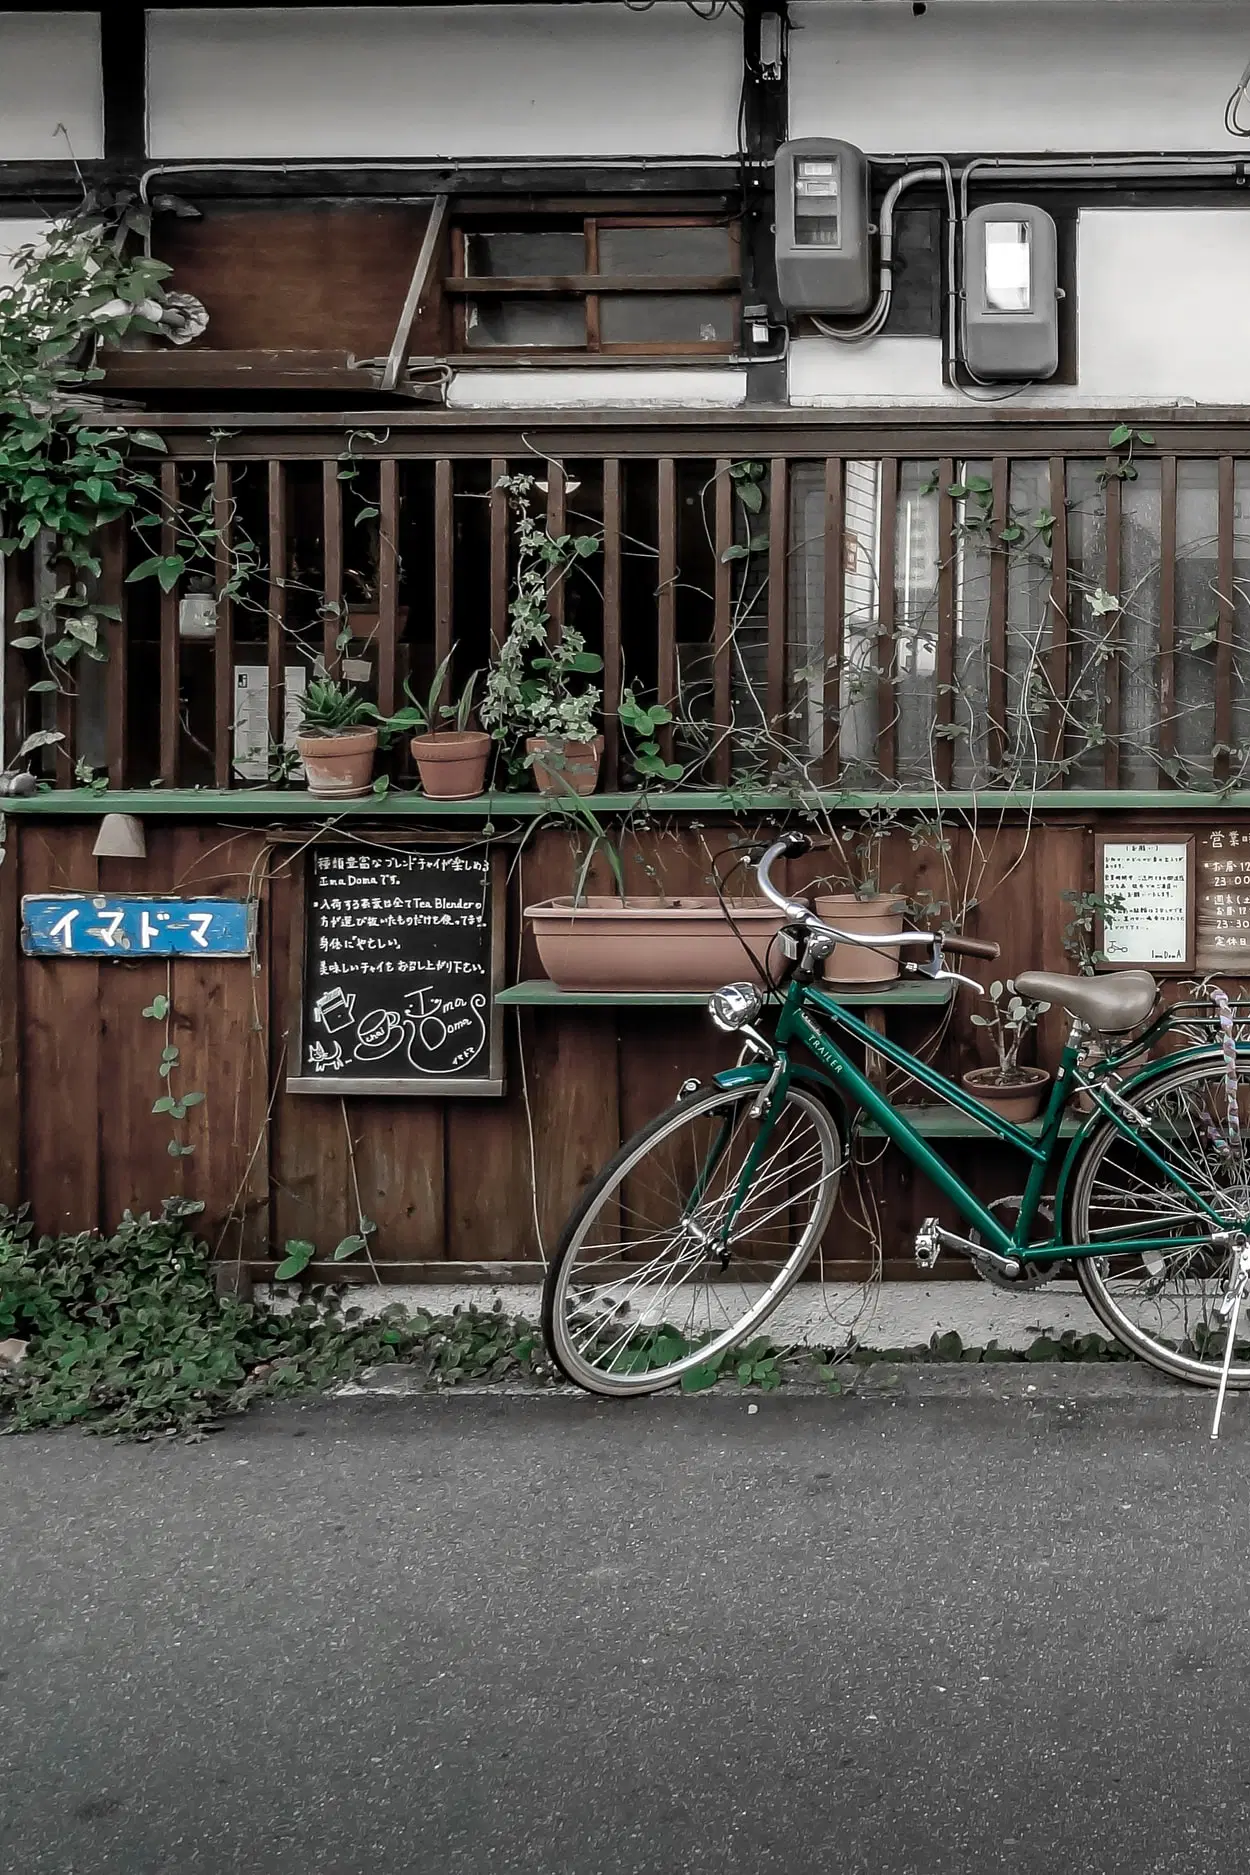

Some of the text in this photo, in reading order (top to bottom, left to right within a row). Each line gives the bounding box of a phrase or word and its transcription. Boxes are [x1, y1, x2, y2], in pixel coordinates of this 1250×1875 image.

[50, 909, 213, 949] イマドマ
[366, 1027, 385, 1042] chai
[808, 1035, 843, 1073] TRAILER
